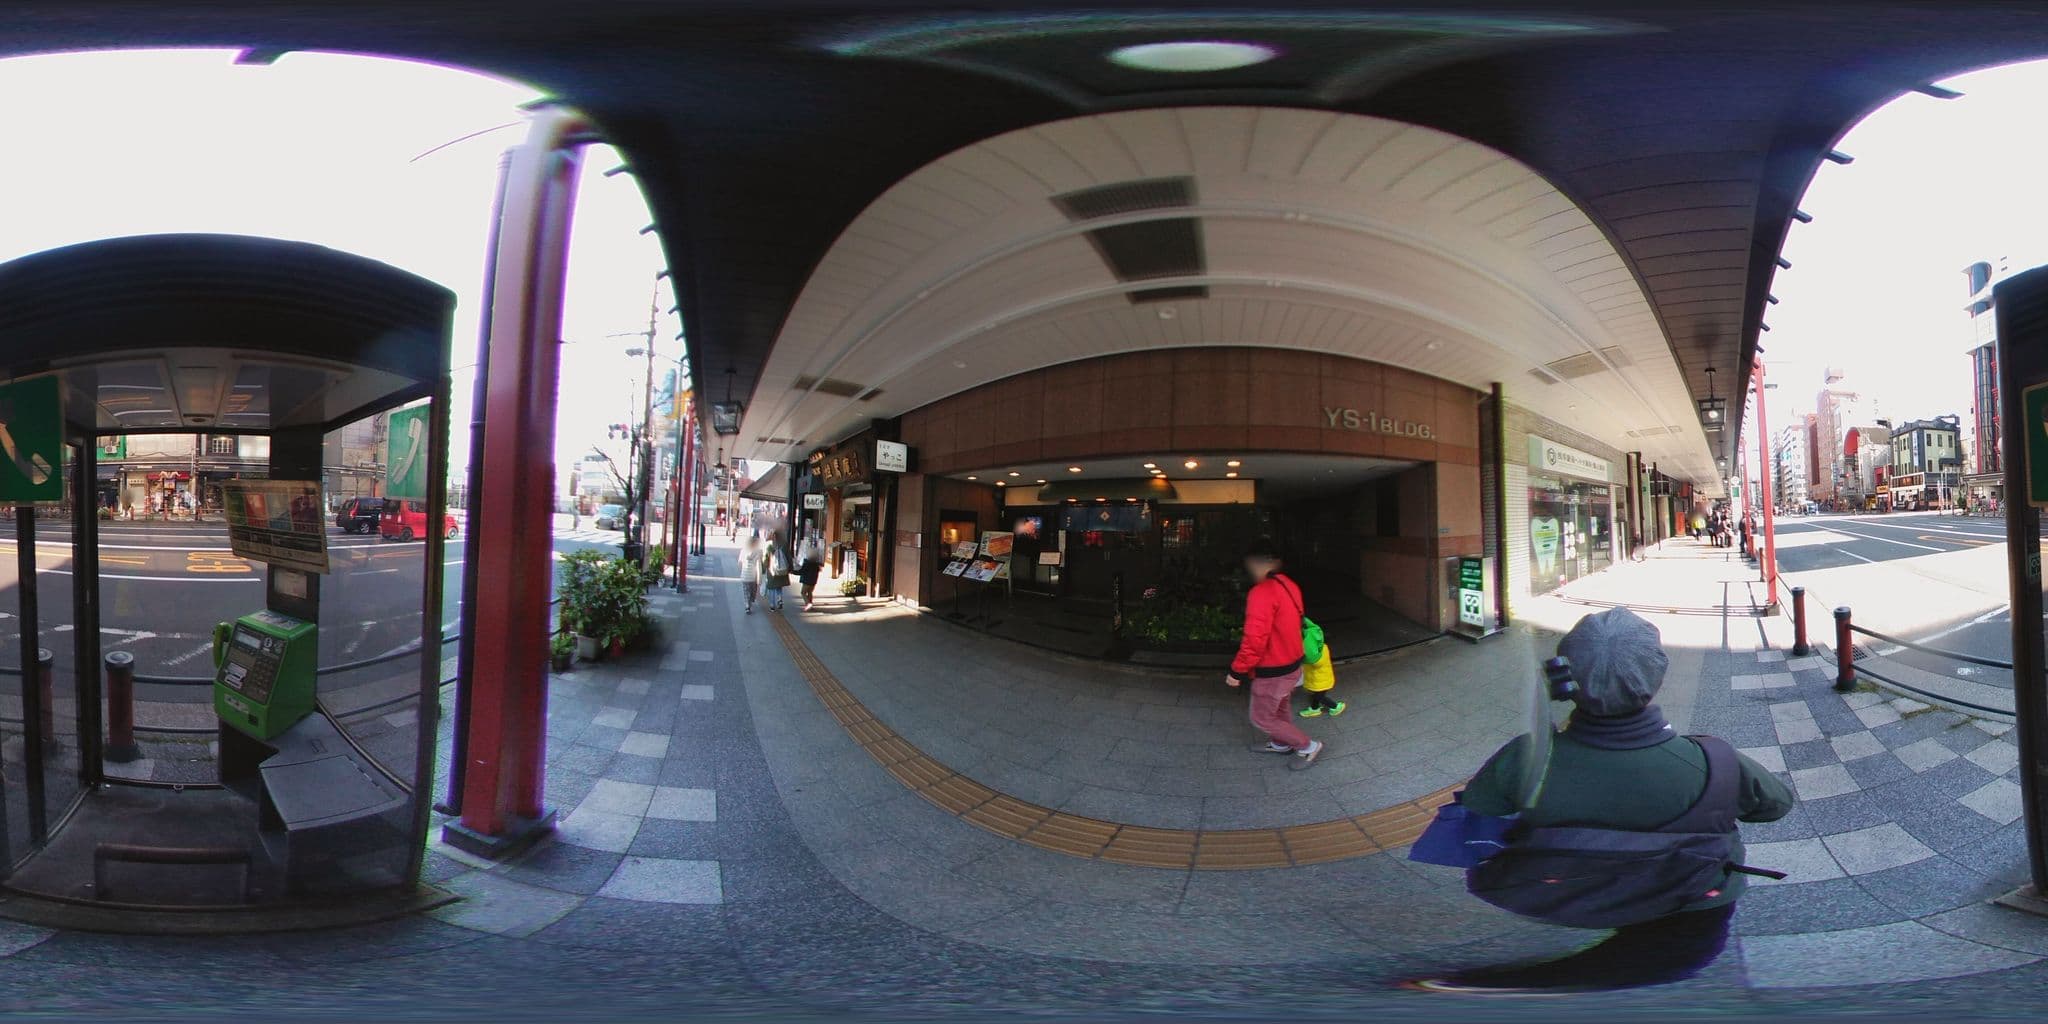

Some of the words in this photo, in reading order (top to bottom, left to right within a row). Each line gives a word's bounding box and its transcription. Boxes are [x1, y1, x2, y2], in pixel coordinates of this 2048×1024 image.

[1324, 406, 1377, 432] YS-1
[1380, 417, 1436, 440] BLDG.
[882, 451, 902, 462] やっこ
